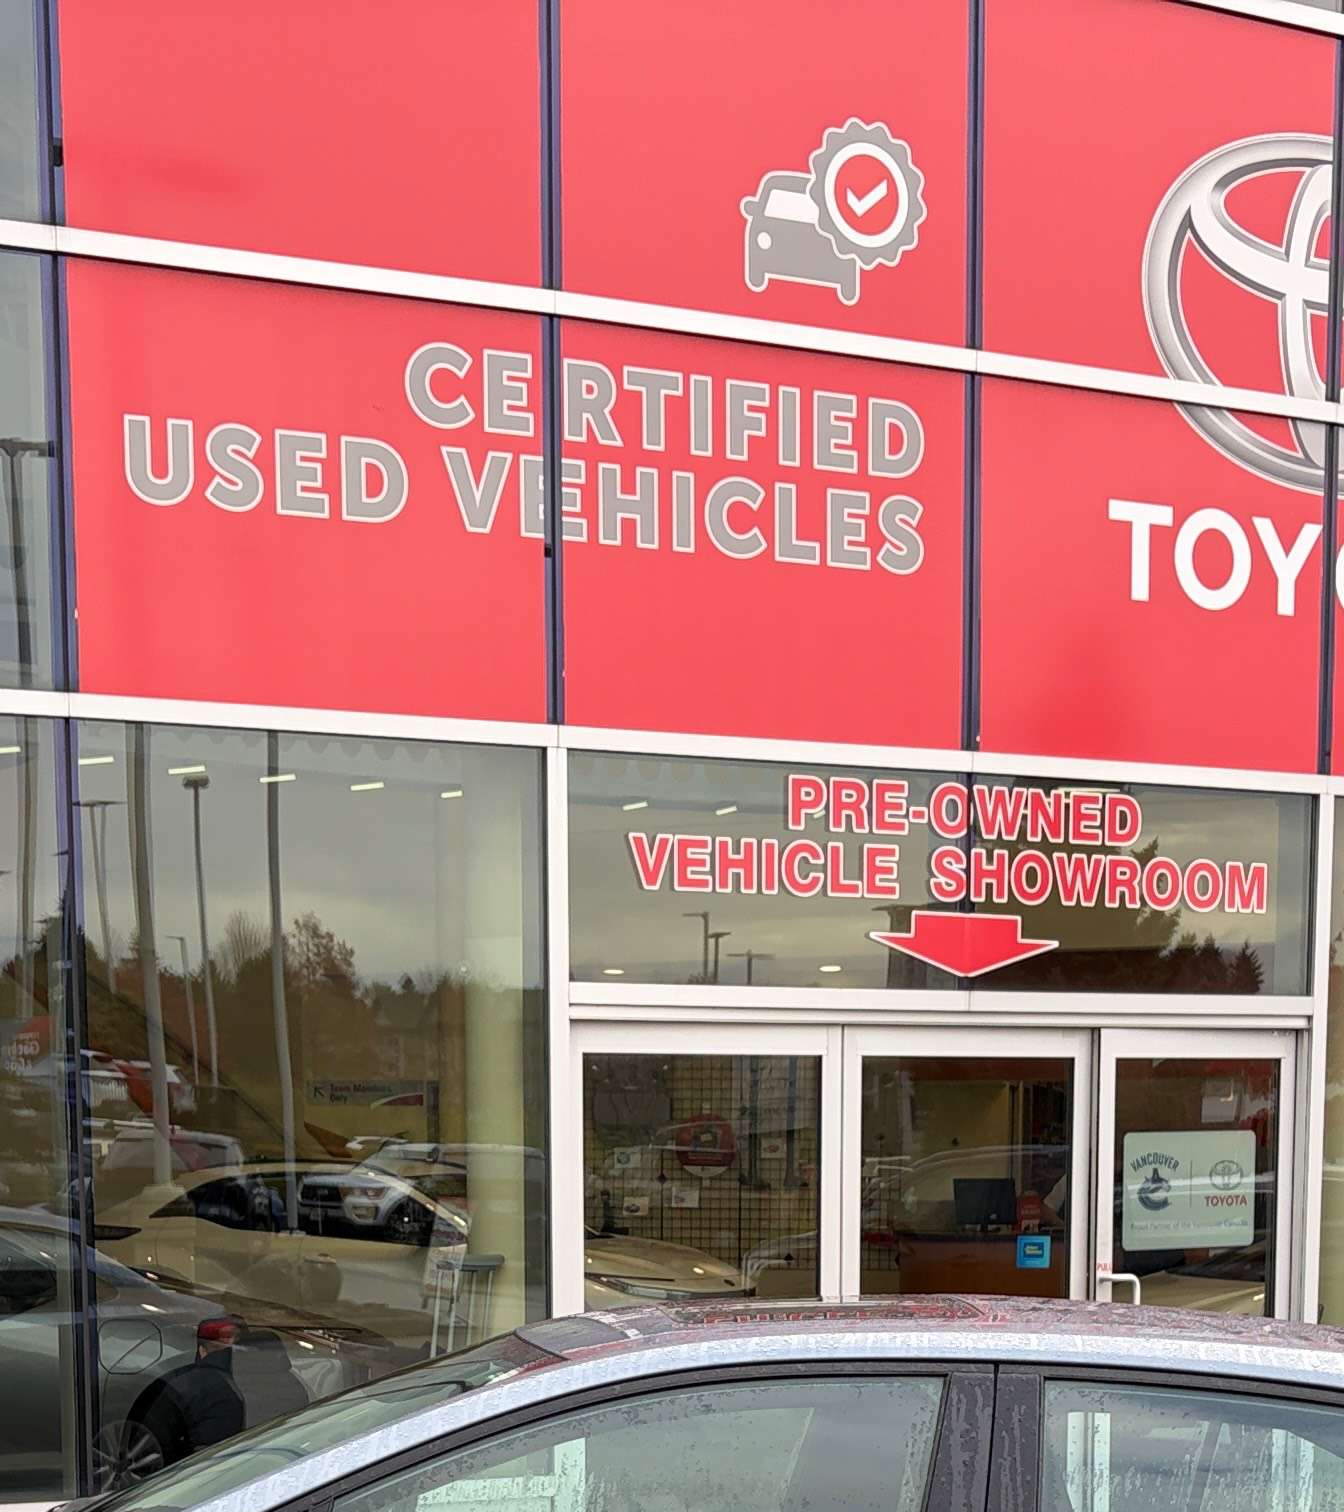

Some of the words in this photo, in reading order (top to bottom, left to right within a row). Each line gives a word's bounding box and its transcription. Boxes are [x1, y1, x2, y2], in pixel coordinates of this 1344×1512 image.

[405, 341, 925, 479] CERTIFIED
[121, 413, 410, 523] USED
[440, 446, 925, 575] VEHICLES
[786, 774, 1143, 847] PRE-OWNED
[629, 832, 901, 899] VEHICLE
[930, 845, 1269, 914] SHOWROOM
[1130, 1152, 1180, 1173] VANCOUVER
[1204, 1194, 1248, 1208] TOYOTA
